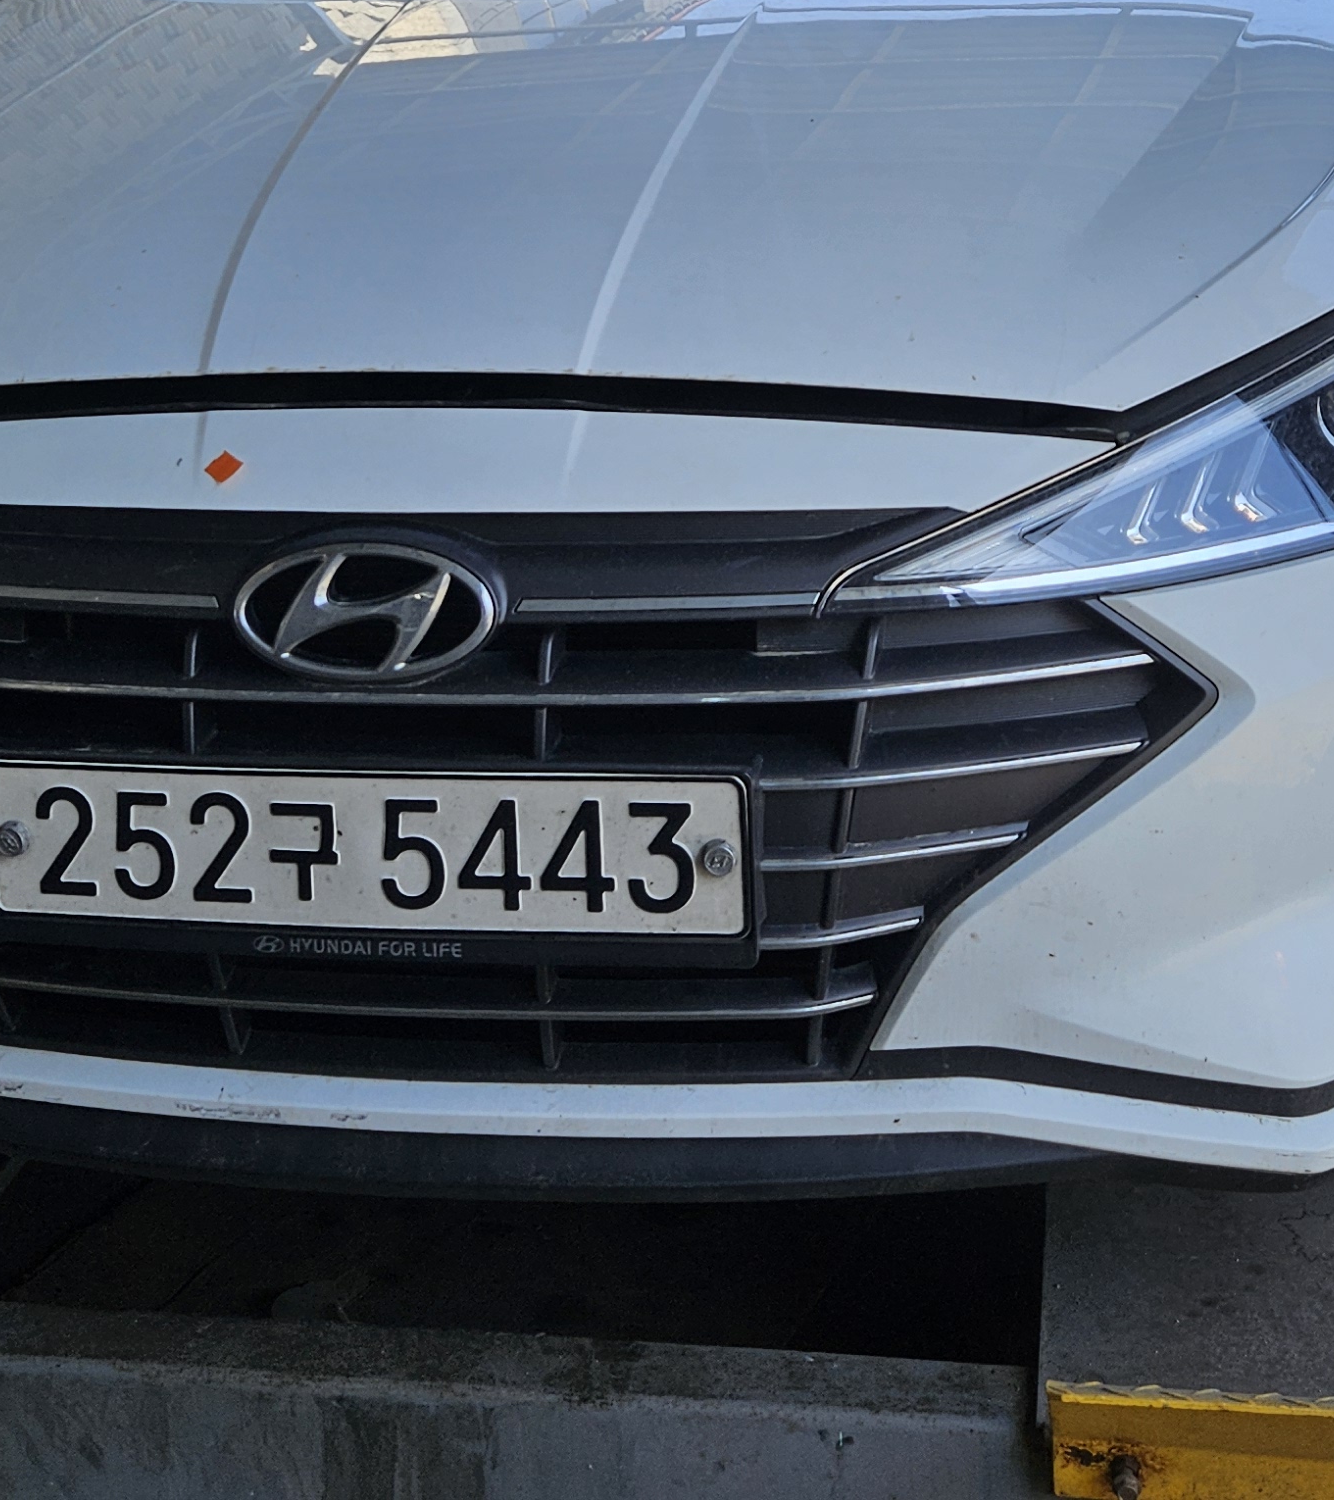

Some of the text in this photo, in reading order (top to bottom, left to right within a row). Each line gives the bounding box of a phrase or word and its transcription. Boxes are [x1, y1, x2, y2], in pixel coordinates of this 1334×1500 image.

[34, 786, 695, 914] 252구 5443
[290, 938, 463, 958] HYUNDAI FOR LIFE
